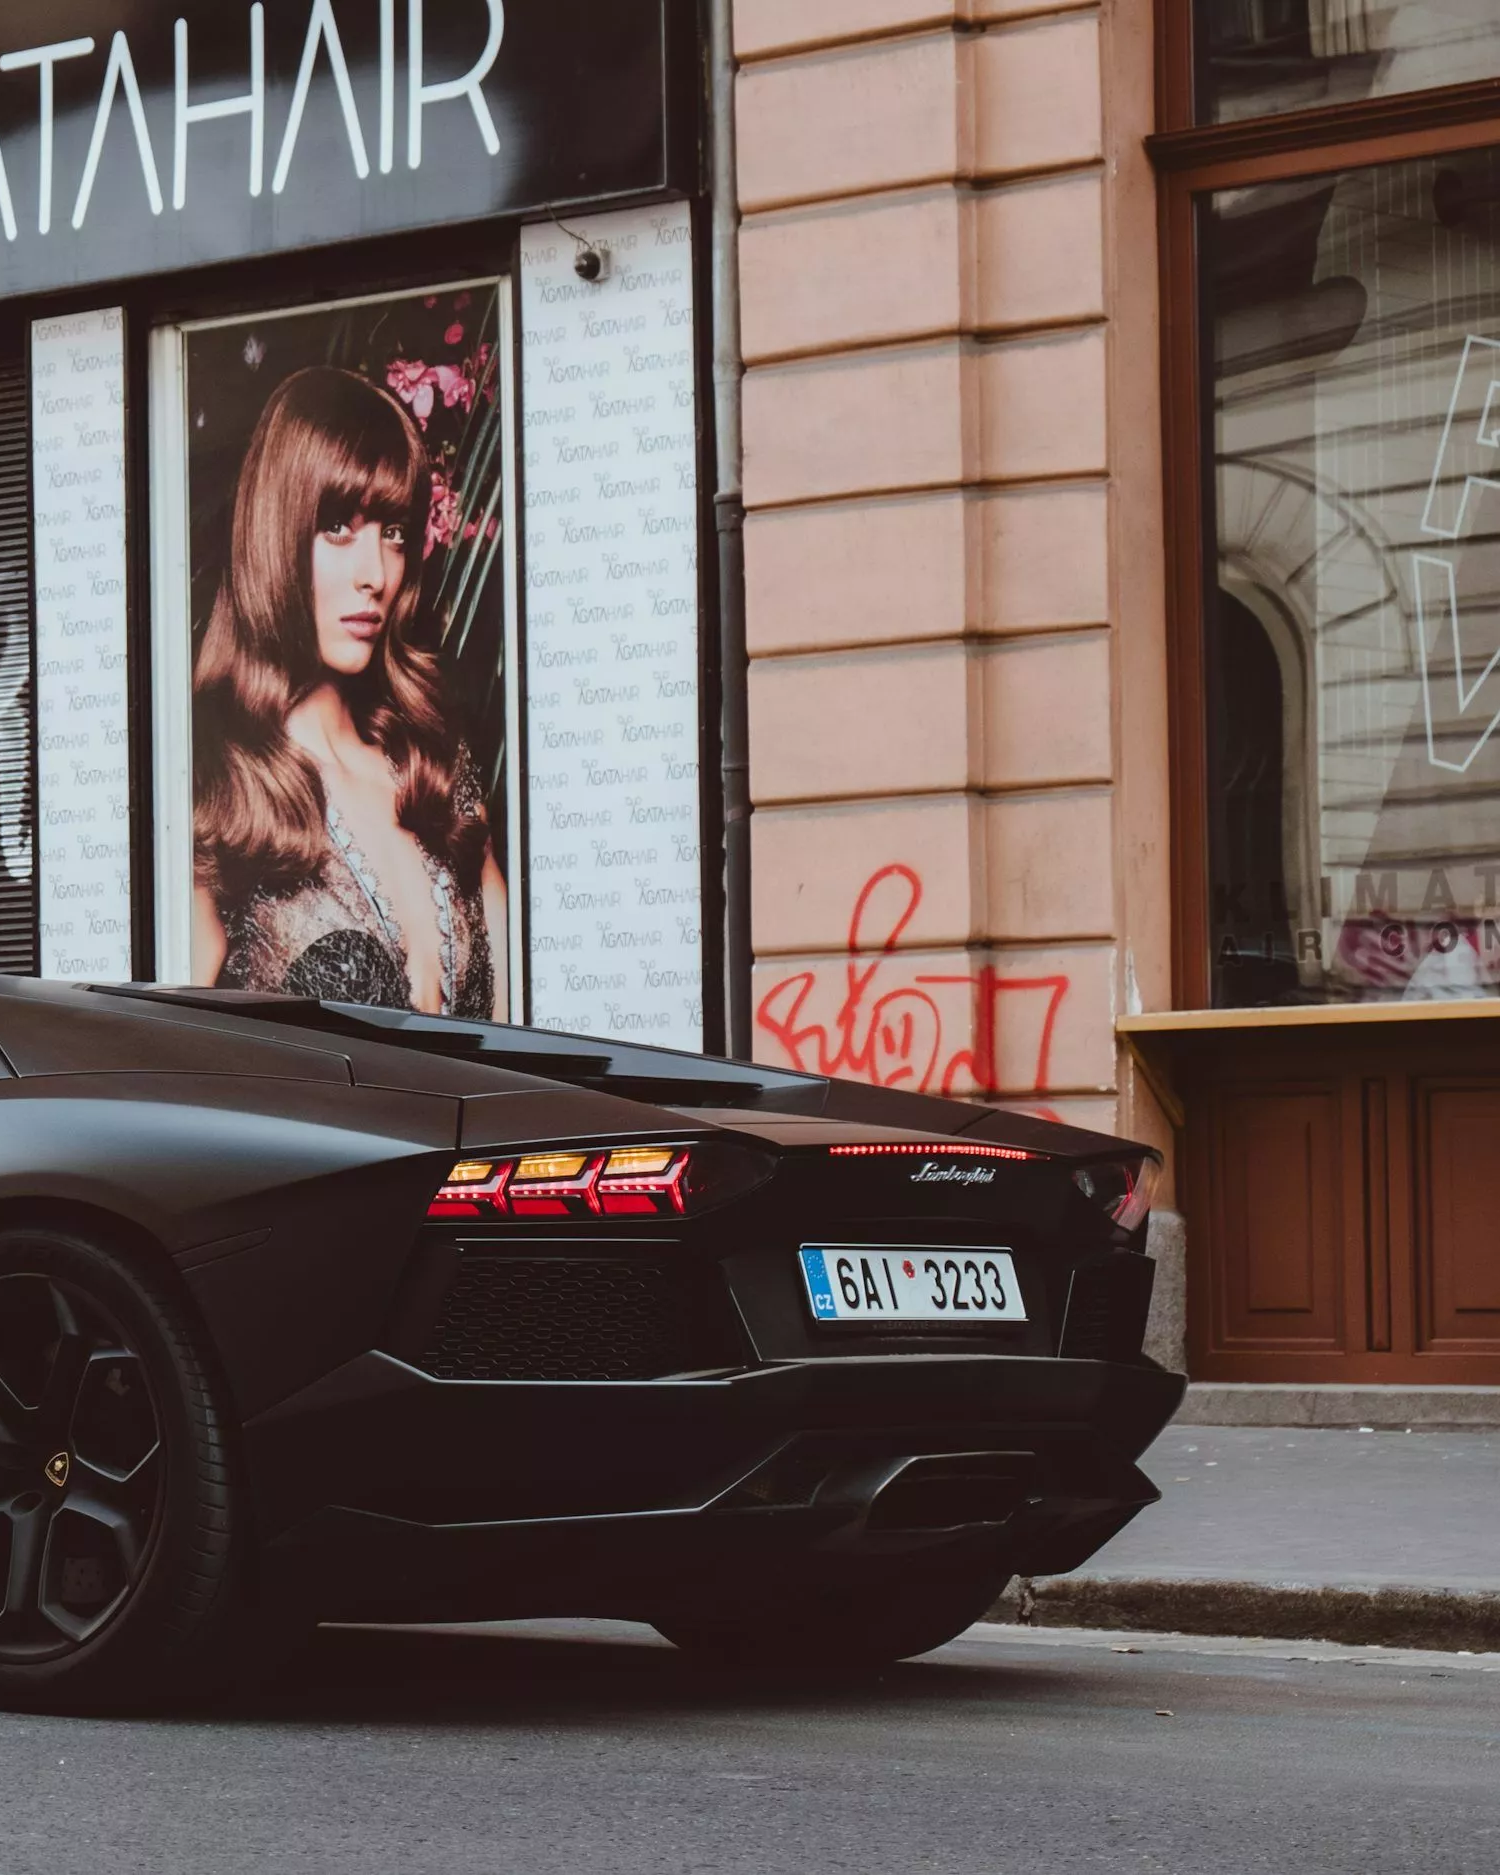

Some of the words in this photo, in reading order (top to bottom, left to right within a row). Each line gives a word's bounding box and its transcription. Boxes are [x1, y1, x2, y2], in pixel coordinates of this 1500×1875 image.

[1216, 927, 1323, 967] AIR
[910, 1162, 997, 1186] Lamborghini
[815, 1294, 834, 1310] CZ
[924, 1259, 1006, 1310] 3233
